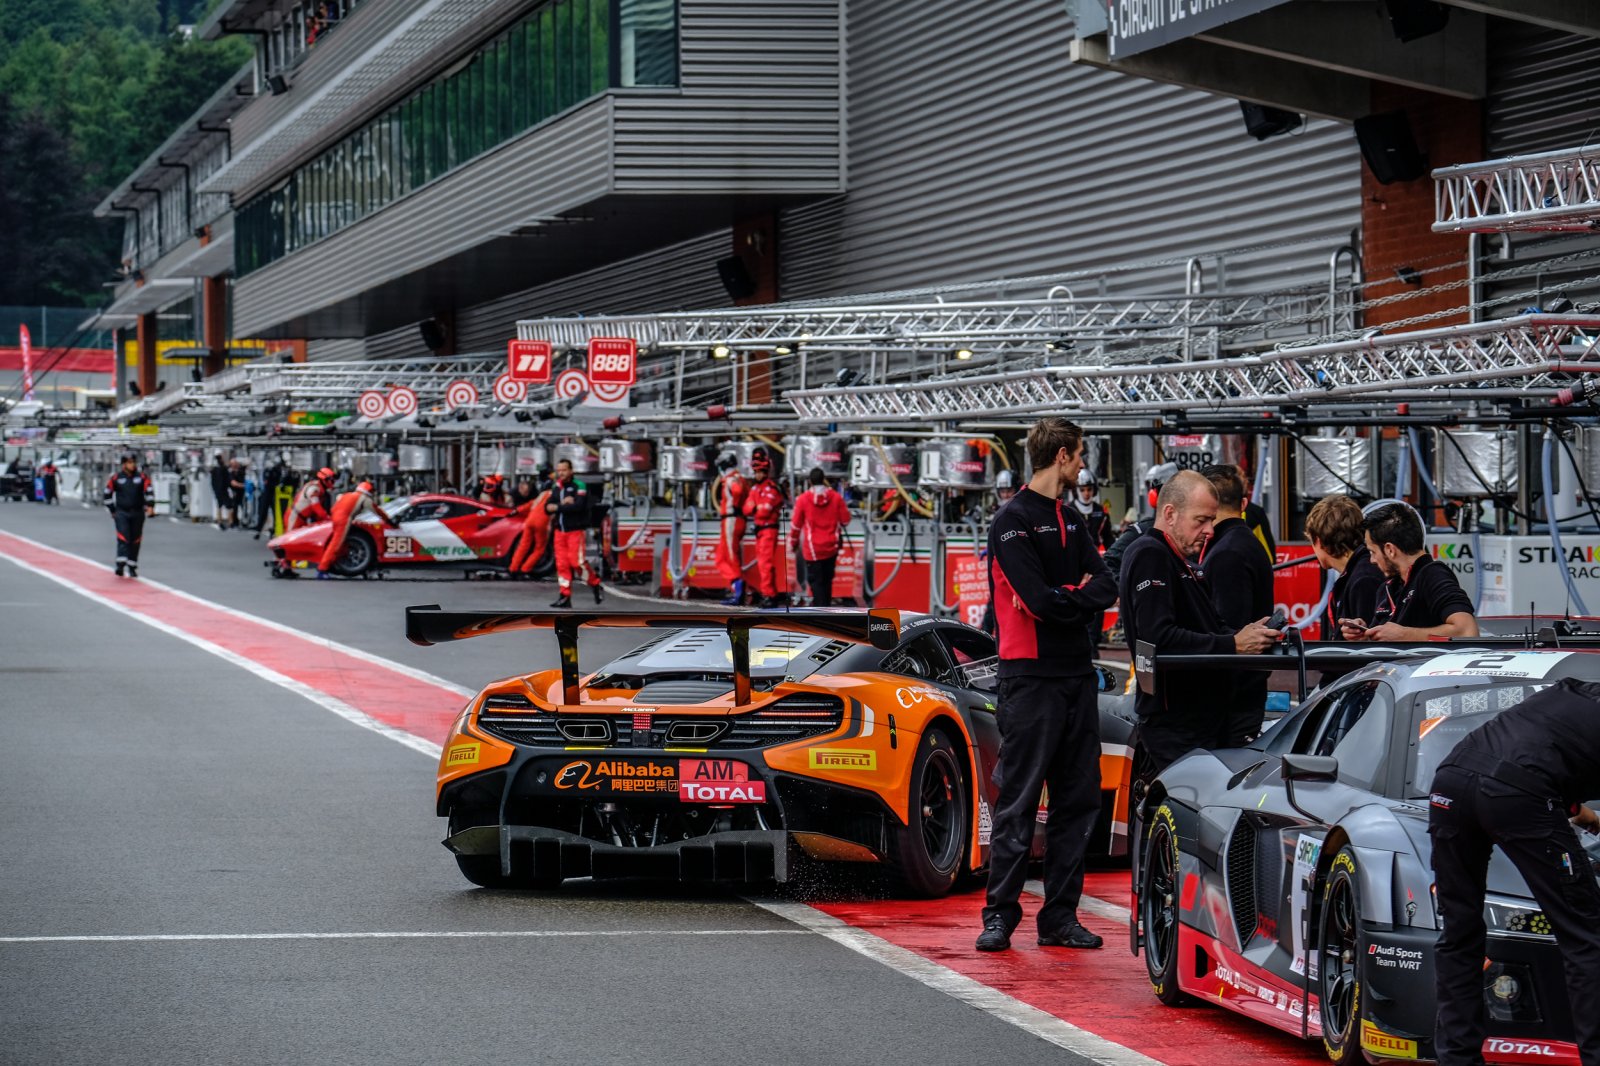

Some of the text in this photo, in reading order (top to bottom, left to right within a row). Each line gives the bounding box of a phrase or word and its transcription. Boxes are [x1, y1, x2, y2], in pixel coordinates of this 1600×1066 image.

[1120, 0, 1165, 39] CIRCUIT
[593, 354, 630, 372] 888
[855, 458, 862, 477] 2
[386, 537, 412, 553] 961
[1464, 655, 1516, 668] 2
[450, 747, 476, 762] PIRELLI
[815, 752, 870, 766] PIRELLI
[595, 761, 674, 777] Alibaba
[694, 761, 733, 780] AM
[681, 783, 763, 801] TOTAL
[1376, 945, 1423, 958] Audi Sport
[1376, 957, 1422, 970] Team WRT
[1363, 1025, 1409, 1051] PIRELLI
[1487, 1039, 1556, 1056] TOTAL
